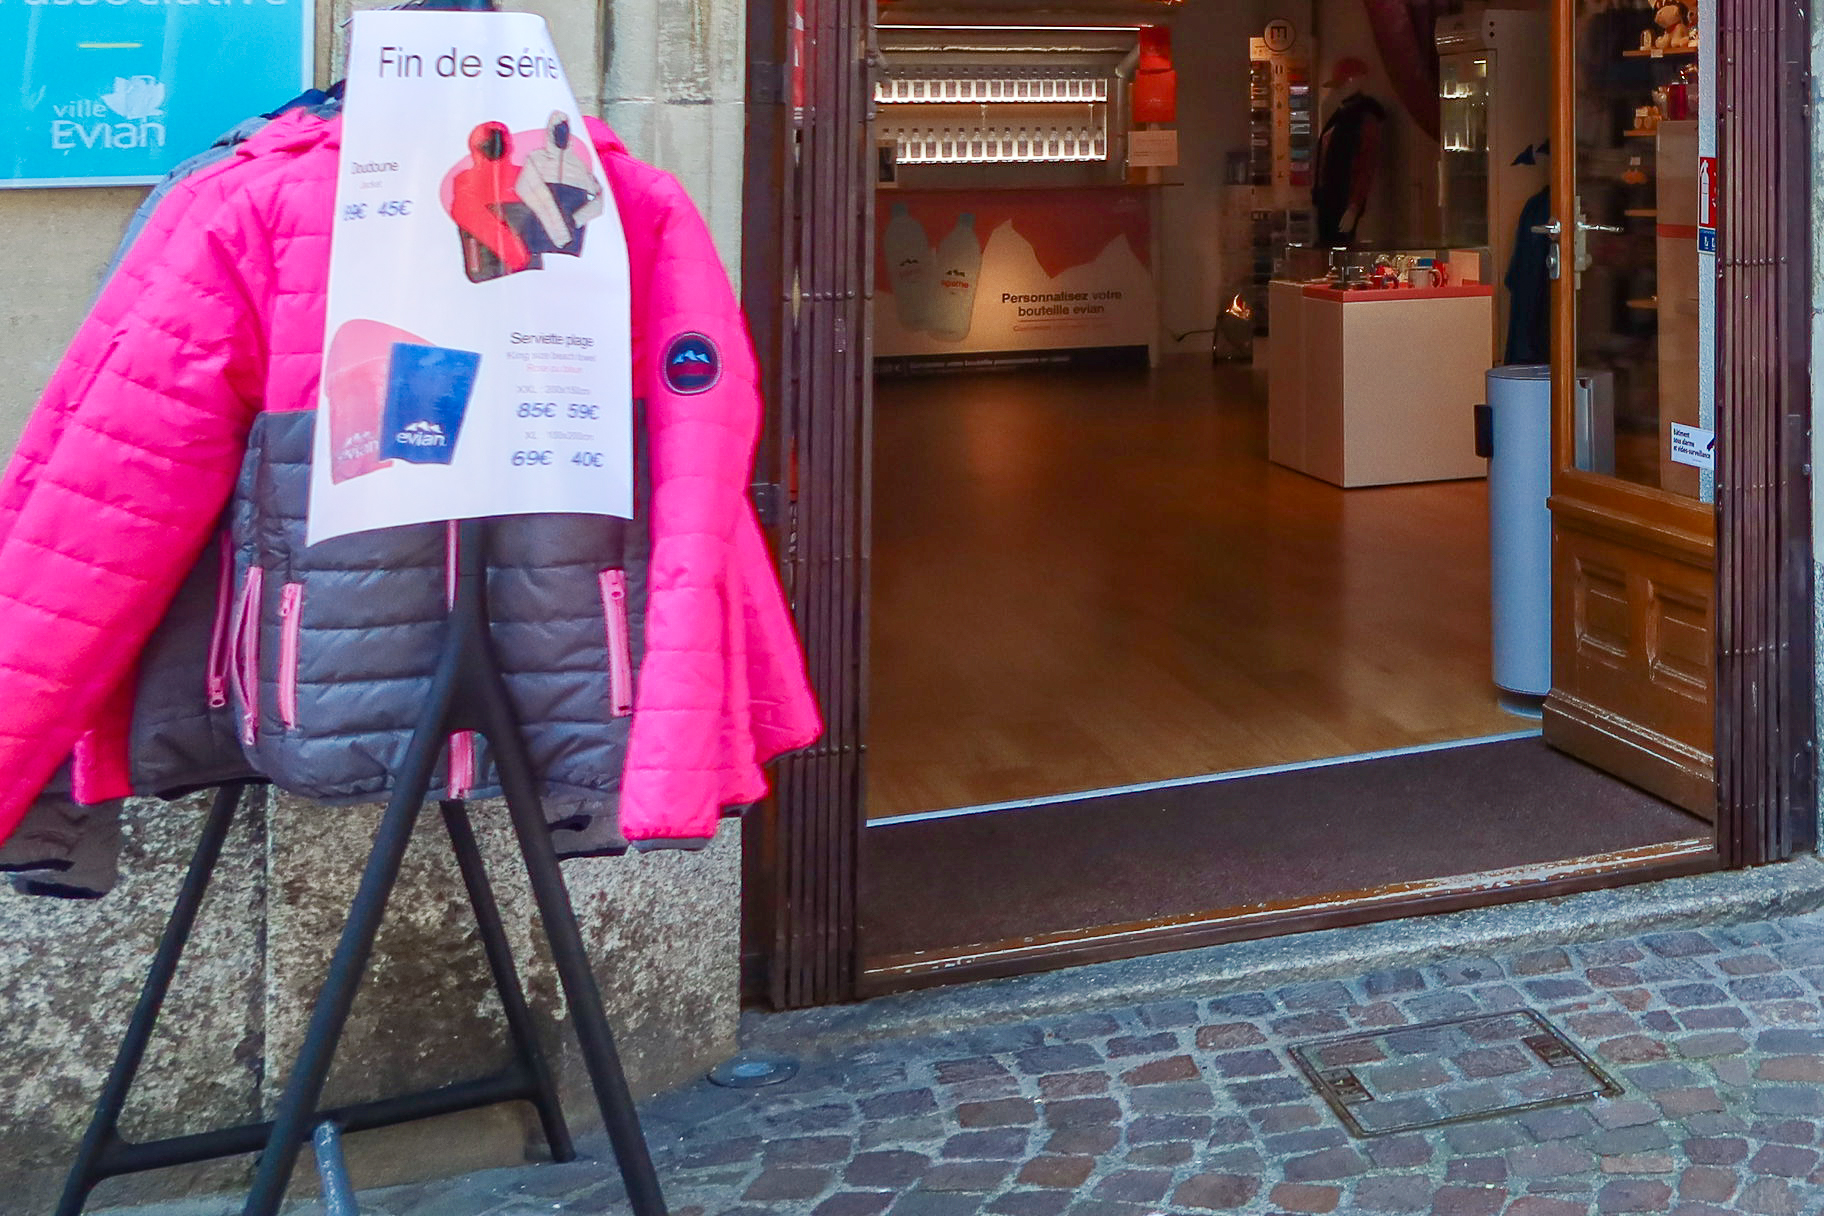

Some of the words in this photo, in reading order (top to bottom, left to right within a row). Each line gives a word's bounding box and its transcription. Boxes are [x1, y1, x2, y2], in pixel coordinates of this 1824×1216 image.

[378, 46, 423, 78] Fin
[435, 47, 483, 78] de
[495, 47, 560, 80] série
[52, 99, 107, 118] ville
[377, 199, 414, 217] 45€
[1002, 291, 1088, 304] Personnalisez
[1092, 290, 1123, 301] votre
[1018, 305, 1070, 317] bouteille
[1073, 303, 1105, 314] evian
[510, 331, 564, 345] Serviette
[516, 402, 558, 418] 85€
[567, 403, 600, 420] 59€
[395, 431, 448, 447] evian
[511, 450, 554, 466] 69€
[570, 451, 604, 468] 40€
